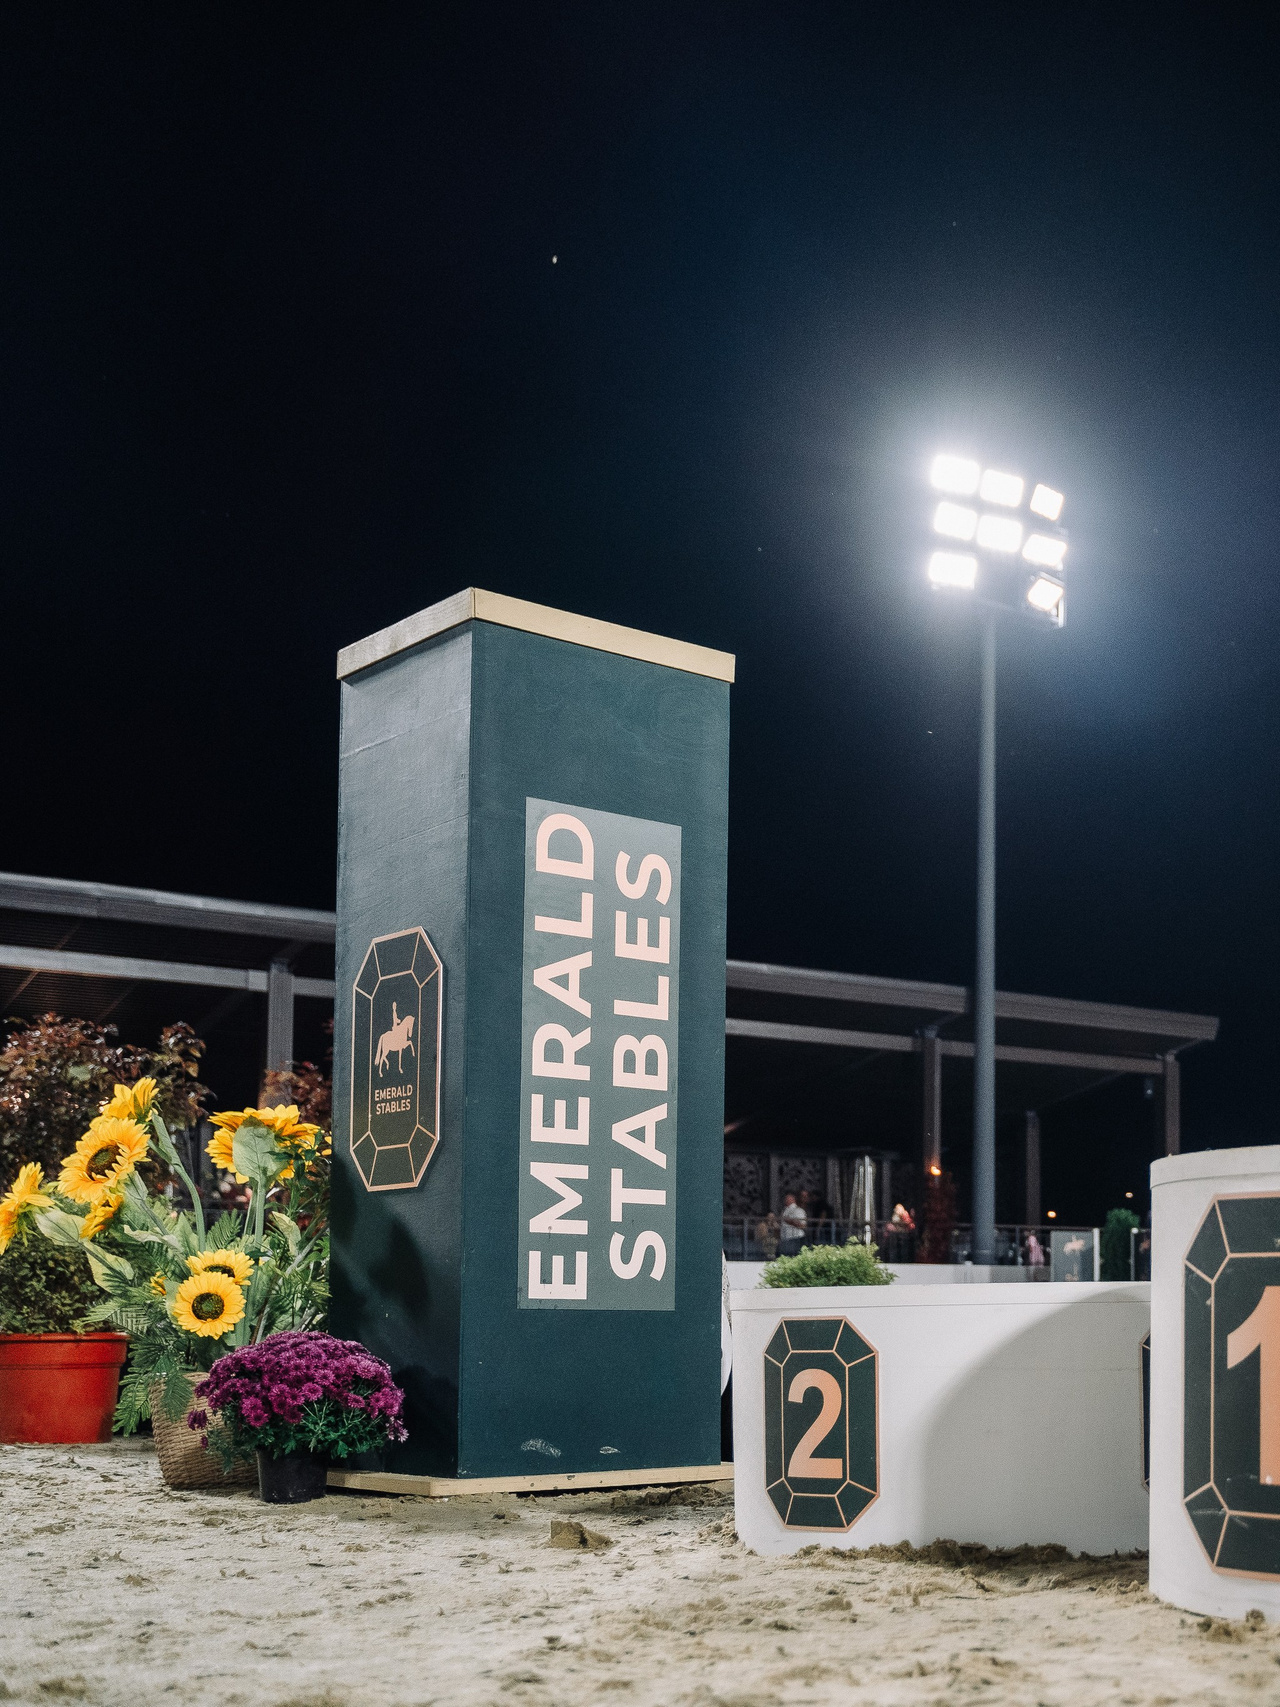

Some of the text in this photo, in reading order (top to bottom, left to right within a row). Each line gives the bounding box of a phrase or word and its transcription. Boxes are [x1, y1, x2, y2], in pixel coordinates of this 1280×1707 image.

[374, 1084, 413, 1102] EMERALD
[376, 1098, 411, 1115] STABLES
[528, 812, 594, 1301] EMERALD
[609, 851, 672, 1282] STABLES
[787, 1368, 843, 1479] 2
